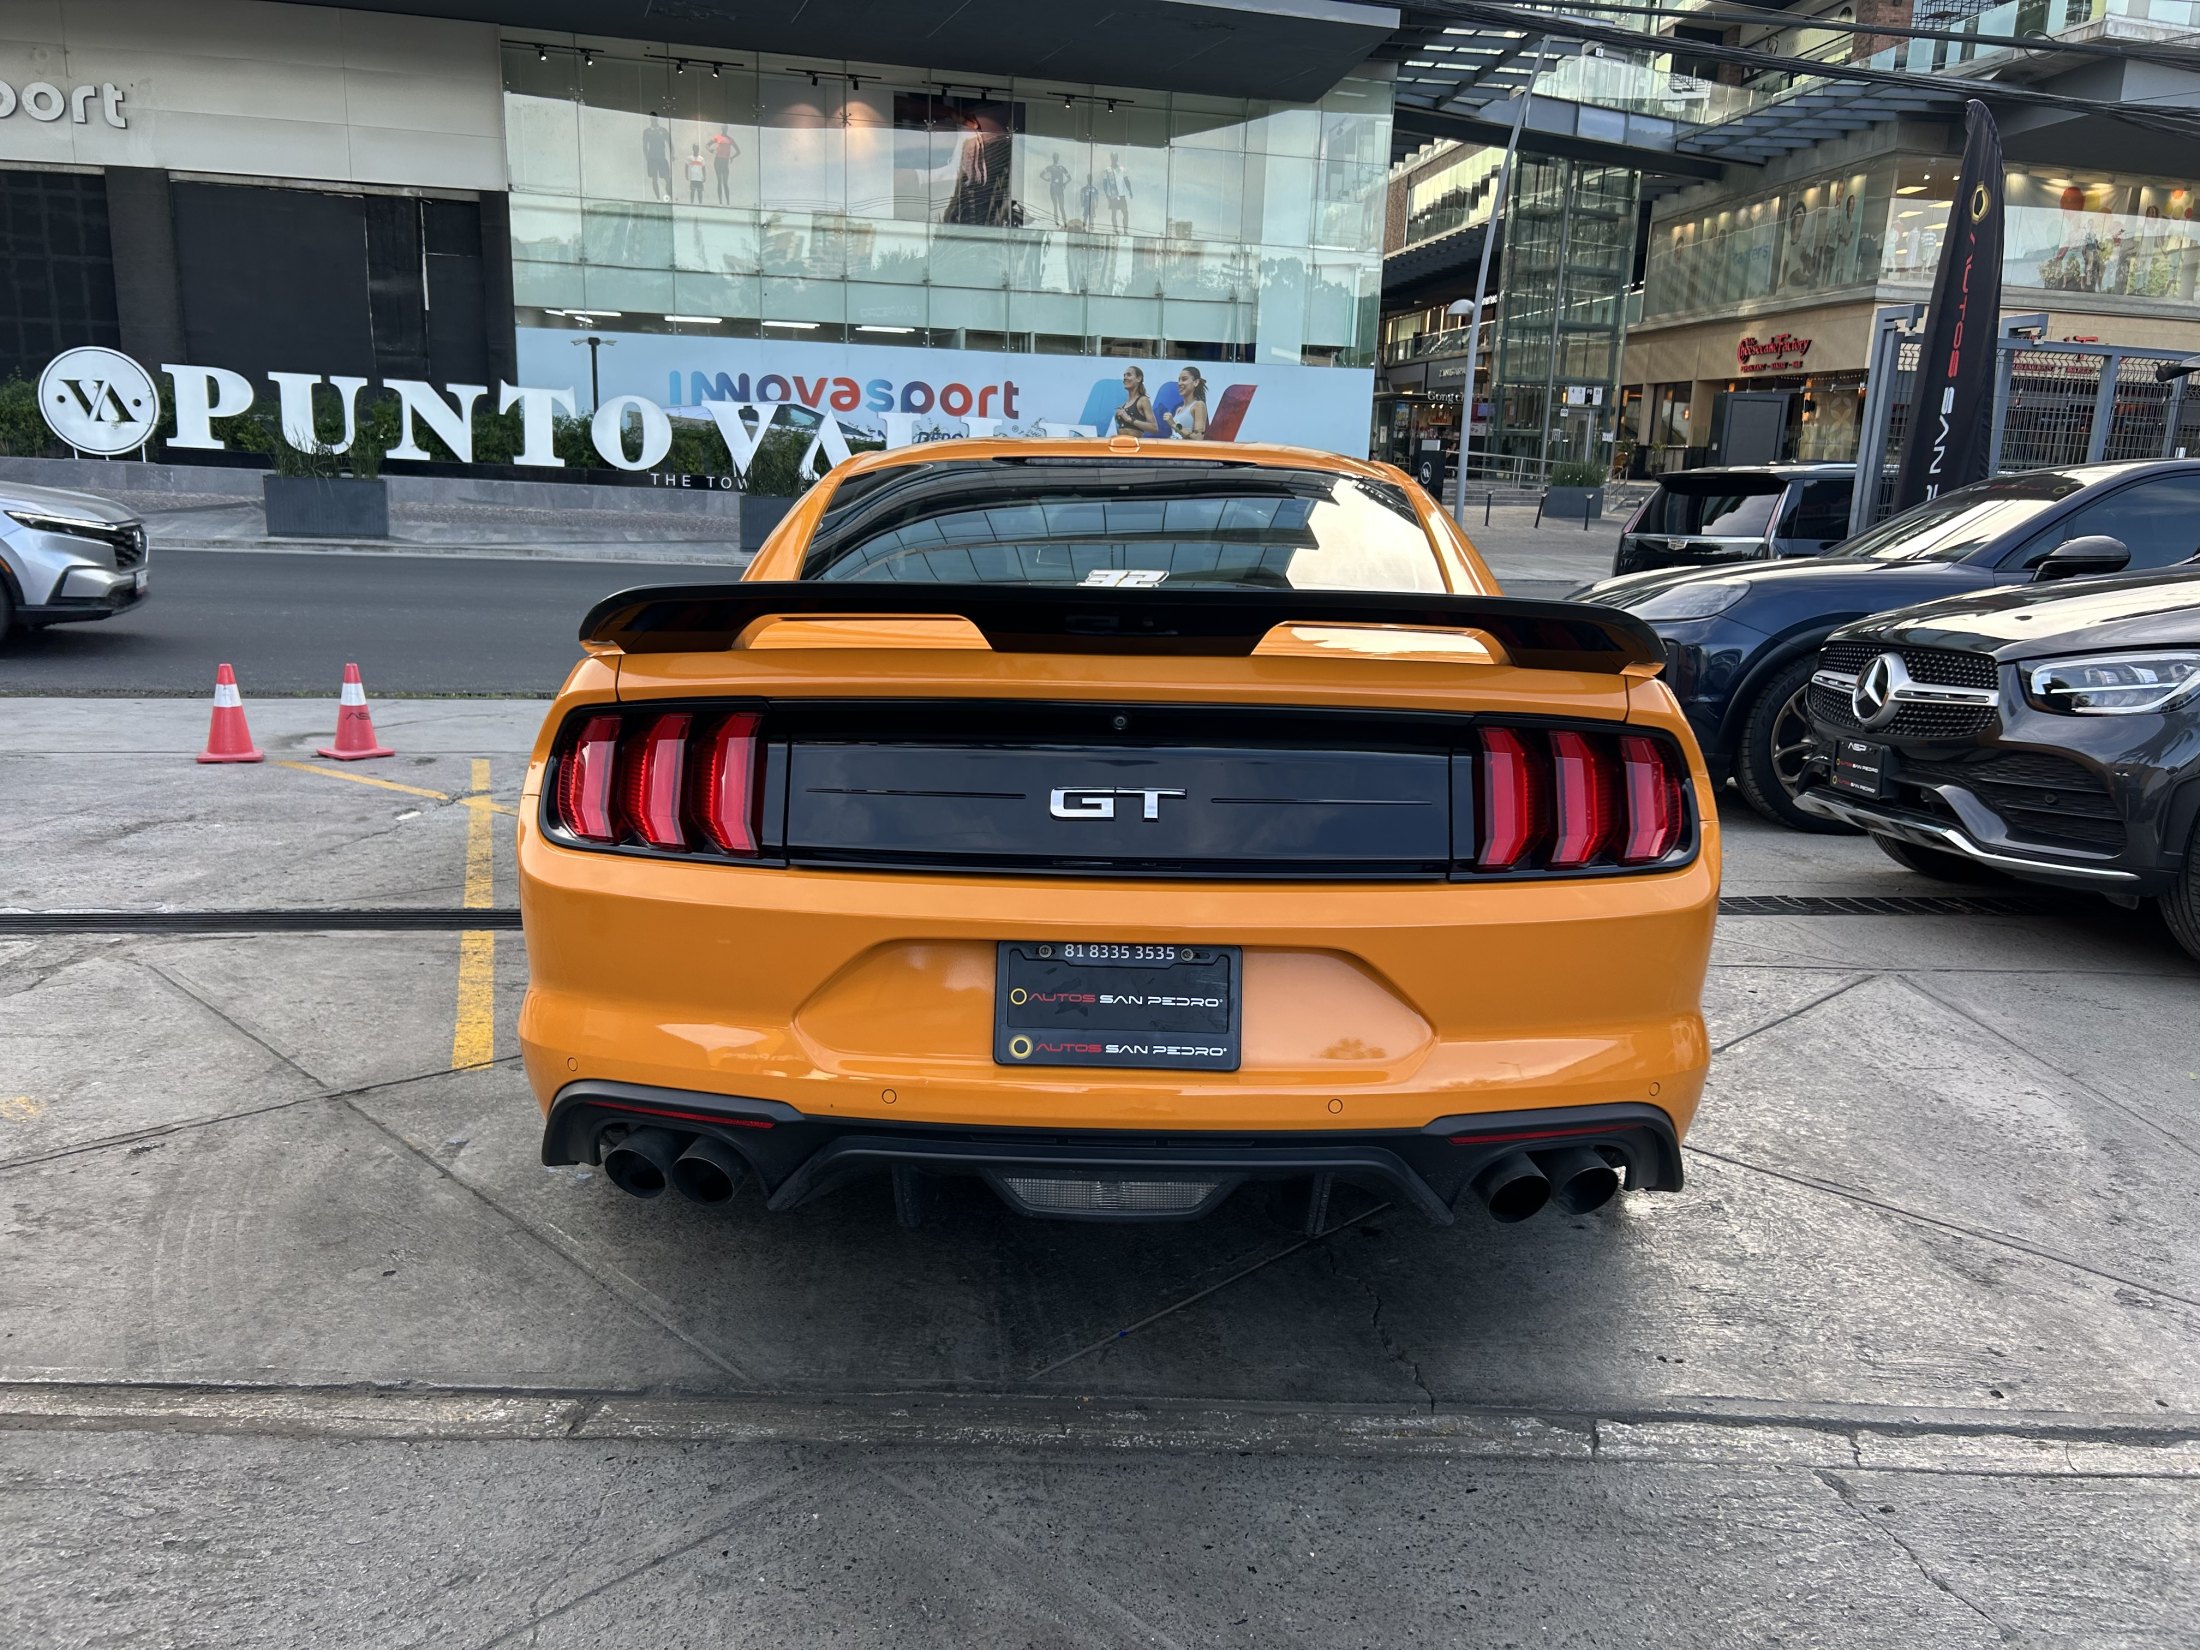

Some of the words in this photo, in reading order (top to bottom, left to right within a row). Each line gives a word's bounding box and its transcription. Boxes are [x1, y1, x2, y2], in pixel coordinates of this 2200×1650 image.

[1947, 231, 1976, 379] AUTOS
[1427, 390, 1454, 405] Gong
[160, 363, 673, 471] PUNTO
[1928, 386, 1955, 475] SAN
[650, 472, 692, 487] THE
[1050, 787, 1187, 822] GT
[1064, 943, 1084, 958] 81
[1089, 945, 1130, 959] 8335
[1134, 945, 1175, 960] 3535
[1028, 992, 1096, 1003] AUTOS
[1099, 994, 1143, 1005] SAN
[1036, 1042, 1102, 1053] AUTOS
[1105, 1044, 1149, 1055] SAN
